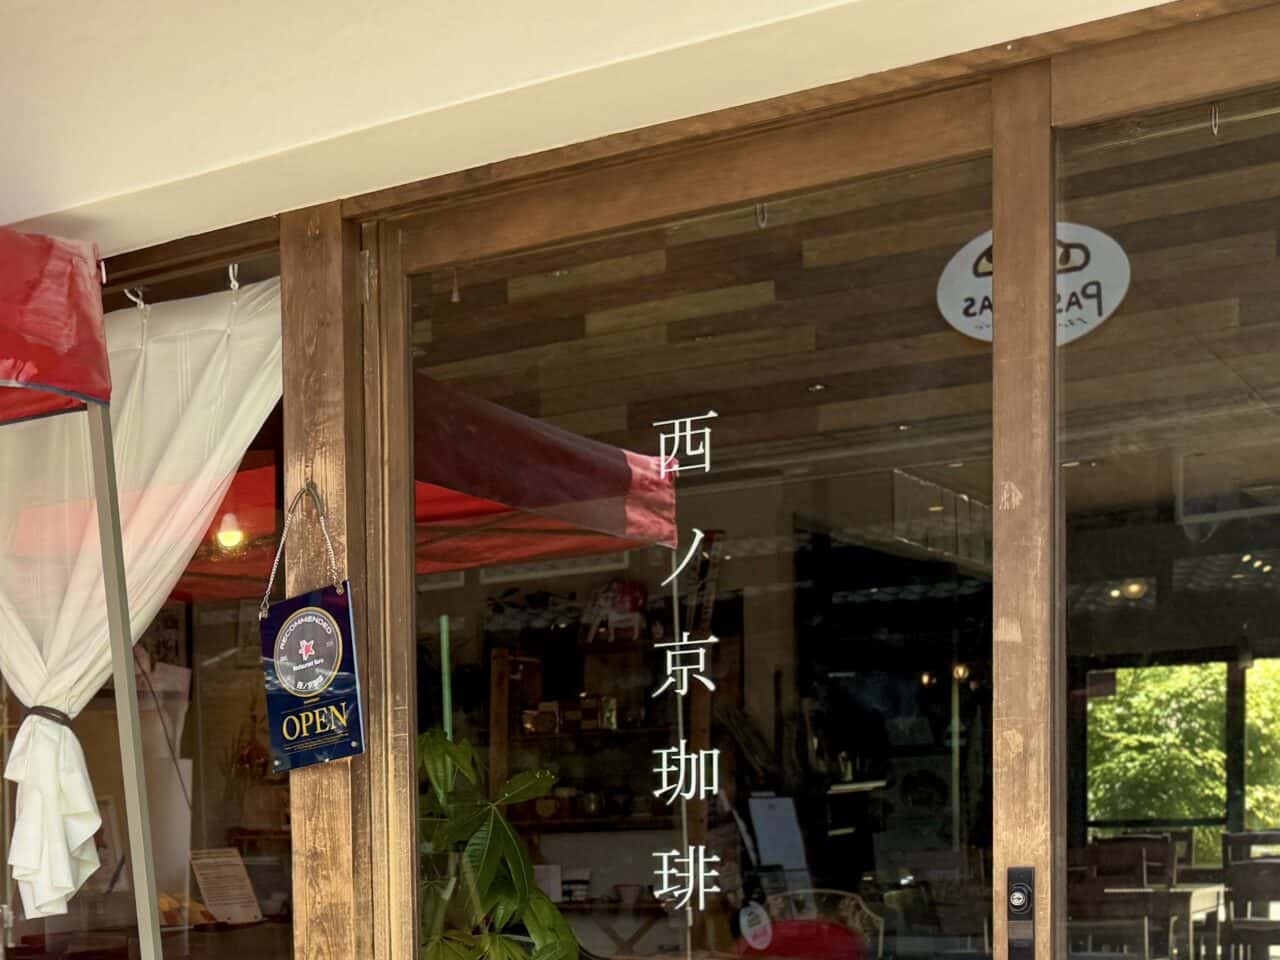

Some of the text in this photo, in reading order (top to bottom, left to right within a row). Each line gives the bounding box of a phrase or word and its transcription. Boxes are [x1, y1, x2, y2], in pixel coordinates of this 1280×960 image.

[279, 615, 333, 650] RECOMMENDED
[651, 410, 721, 911] 西ノ京珈琲
[282, 703, 348, 741] OPEN
